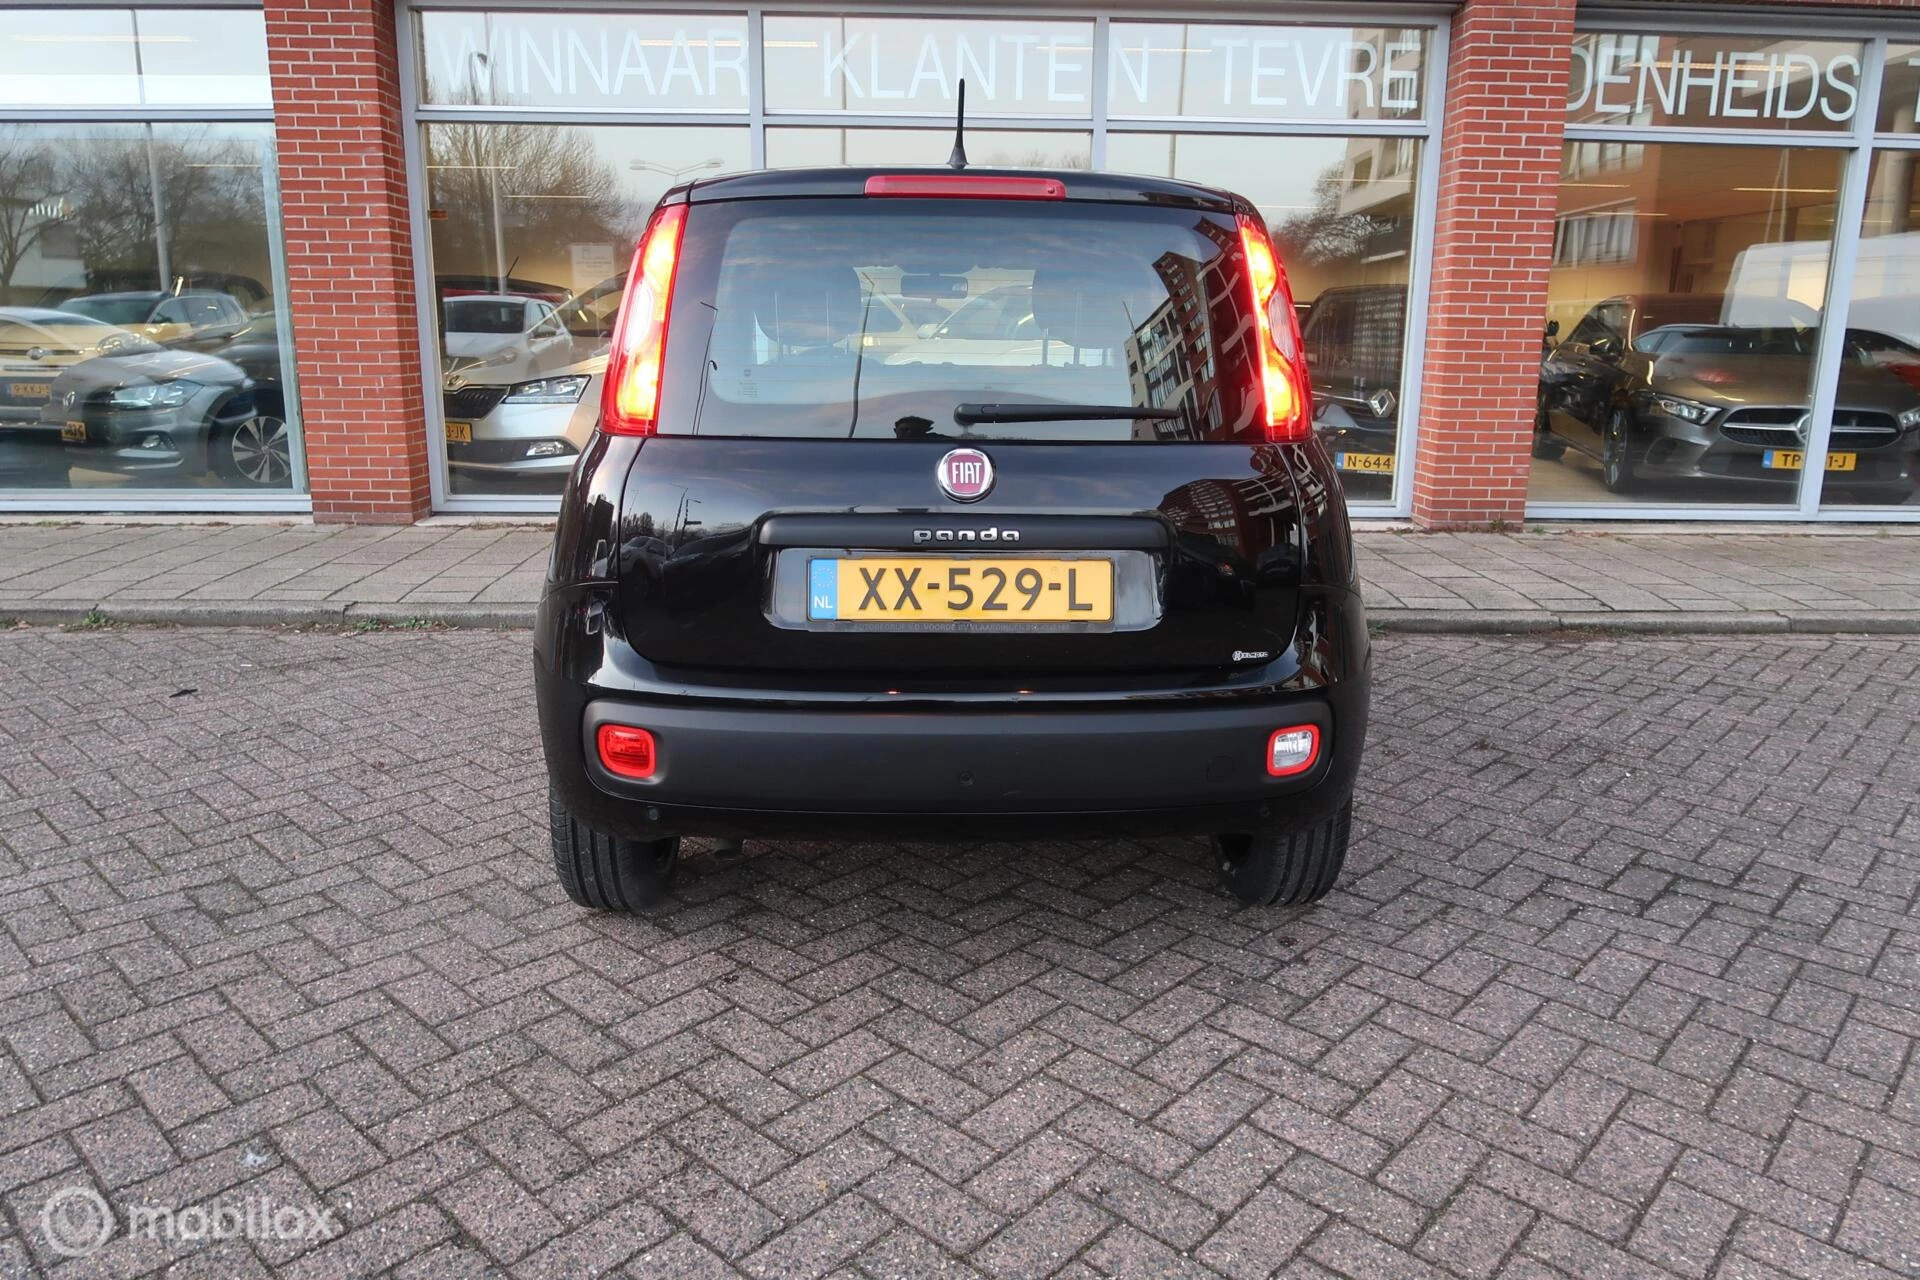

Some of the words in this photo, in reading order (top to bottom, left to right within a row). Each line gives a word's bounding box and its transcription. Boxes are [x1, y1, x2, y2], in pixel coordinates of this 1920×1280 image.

[437, 27, 748, 96] WINNAAR
[952, 462, 982, 484] FIAT
[913, 527, 1020, 543] panda
[858, 567, 1093, 611] XX-529-L
[814, 595, 834, 609] NL
